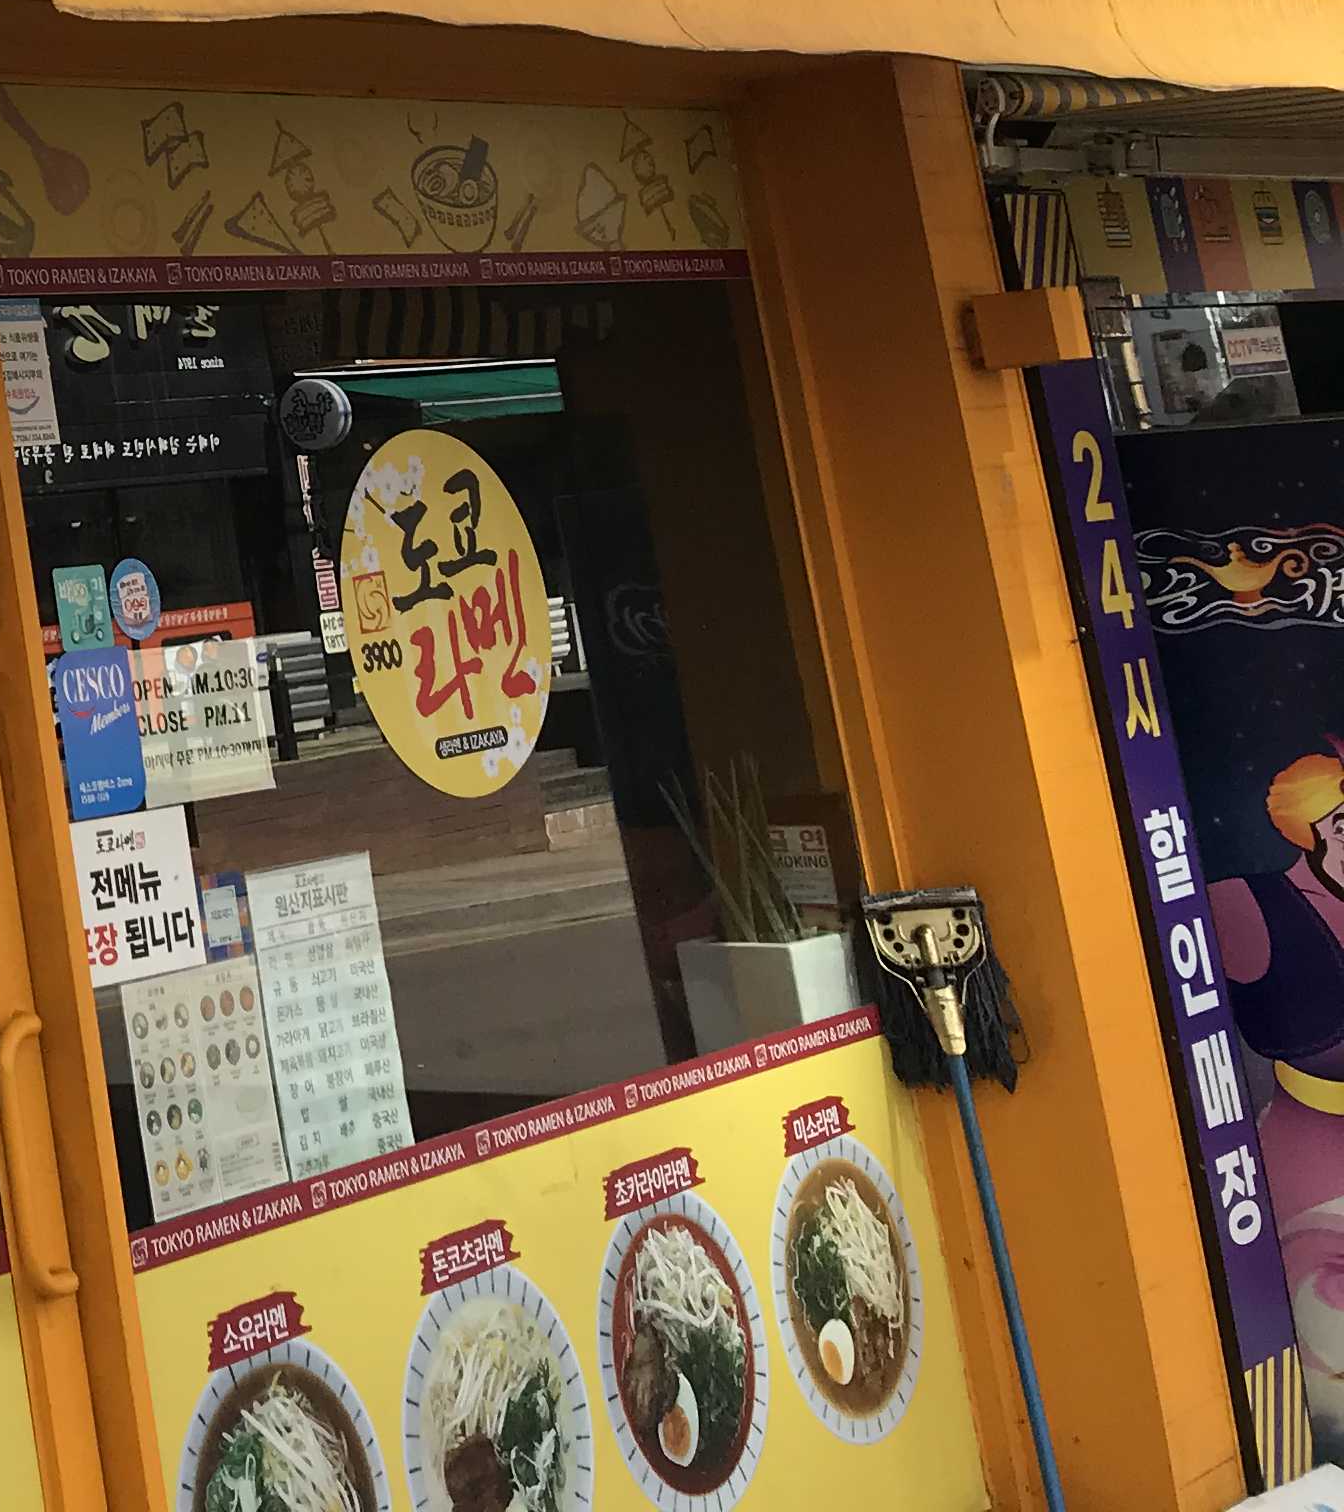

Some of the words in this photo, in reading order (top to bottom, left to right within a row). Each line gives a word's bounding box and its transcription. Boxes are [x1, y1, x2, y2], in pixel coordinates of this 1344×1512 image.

[7, 268, 50, 286] TOKYO
[52, 268, 96, 285] RAMEN
[97, 267, 107, 284] &
[108, 266, 158, 284] IZAKAYA
[184, 266, 223, 283] TOKYO
[224, 266, 265, 282] RAMEN
[275, 265, 321, 281] IZAKAYA
[348, 264, 382, 279] TOKYO
[383, 264, 420, 278] RAMEN
[429, 262, 471, 278] IZAKAYA
[493, 263, 526, 277] TOKYO
[527, 262, 560, 276] RAMEN
[361, 638, 402, 673] 3900
[410, 549, 537, 720] 라멘
[63, 663, 125, 705] CESCO
[133, 679, 174, 702] OPEN
[90, 700, 131, 736] Members
[137, 710, 190, 738] CLOSE
[204, 701, 252, 729] PM.11
[469, 728, 506, 750] IZAKAYA
[776, 854, 829, 869] OKING
[89, 861, 162, 911] 전메뉴
[275, 881, 349, 918] 원산지표시판
[124, 906, 196, 960] 됩니다
[767, 1038, 797, 1062] TOKYO
[796, 1029, 829, 1054] RAMEN
[828, 1028, 838, 1044] &
[836, 1016, 873, 1041] IZAKAYA
[1143, 805, 1262, 1246] 할인매장
[640, 1077, 671, 1102] TOKYO
[671, 1067, 706, 1093] RAMEN
[705, 1064, 714, 1082] &
[713, 1053, 752, 1079] IZAKAYA
[491, 1123, 528, 1150] TOKYO
[528, 1111, 566, 1139] RAMEN
[565, 1109, 574, 1127] &
[573, 1095, 617, 1124] IZAKAYA
[792, 1105, 840, 1145] 미소라멘
[328, 1172, 369, 1202] TOKYO
[368, 1158, 411, 1189] RAMEN
[410, 1156, 420, 1176] &
[419, 1142, 466, 1172] IZAKAYA
[614, 1155, 692, 1208] 초카라이라멘
[151, 1227, 195, 1258] TOKYO
[196, 1210, 241, 1244] RAMEN
[241, 1208, 253, 1230] &
[252, 1193, 303, 1225] IZAKAYA
[431, 1229, 505, 1284] 돈코츠라멘
[222, 1303, 290, 1355] 소유라멘
